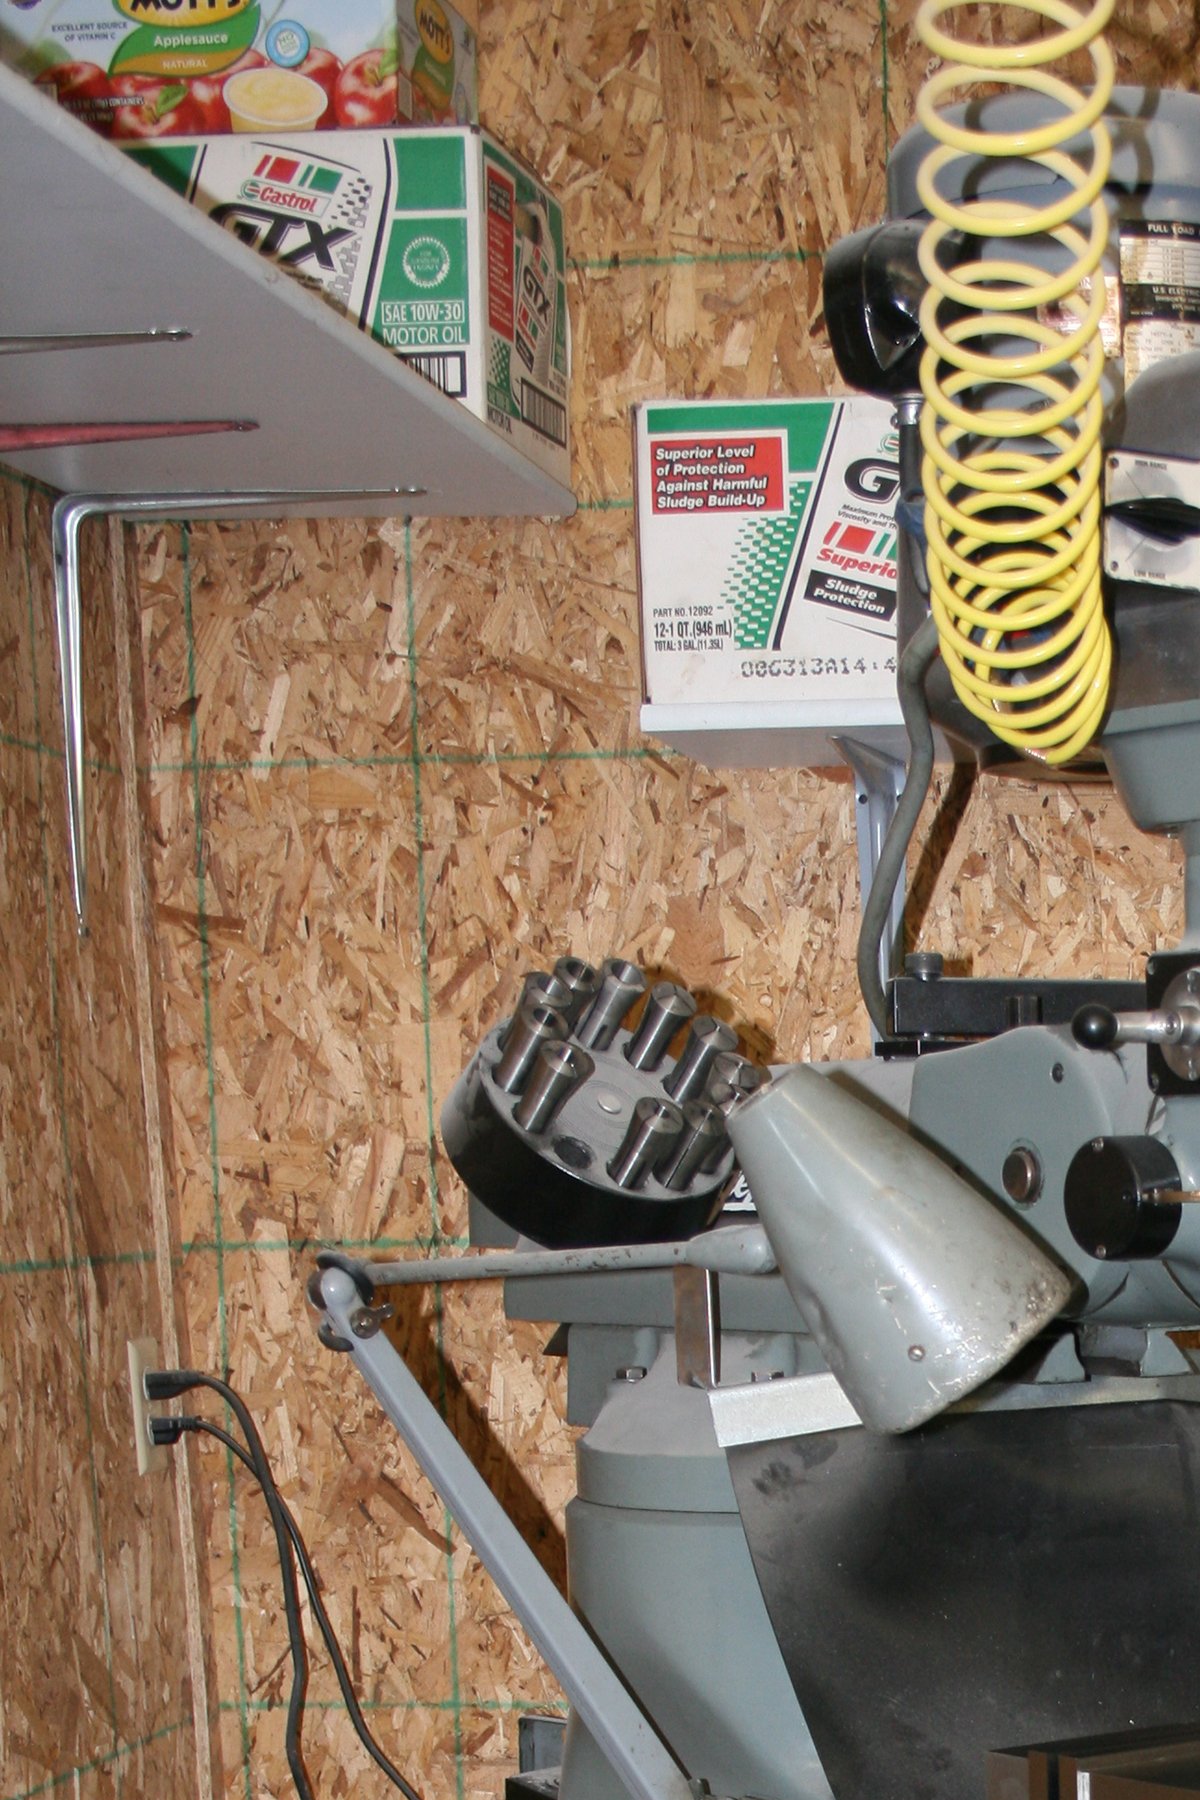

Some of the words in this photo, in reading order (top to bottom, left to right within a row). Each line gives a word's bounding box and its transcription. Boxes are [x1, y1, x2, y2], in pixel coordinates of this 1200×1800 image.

[51, 23, 95, 33] EXCELLENT
[96, 21, 128, 31] SOURCE
[64, 33, 76, 41] OF
[77, 31, 109, 41] VITAMIN
[109, 31, 116, 40] C
[153, 33, 229, 49] Applesauce
[162, 59, 208, 70] NATURAL
[259, 185, 318, 214] Castrol
[208, 202, 357, 272] GTX
[1147, 223, 1169, 234] FULL
[523, 264, 553, 322] GTX
[384, 303, 408, 322] SAE
[410, 302, 462, 321] 10W-30
[383, 327, 439, 345] MOTOR
[442, 326, 467, 343] OIL
[655, 447, 714, 462] Superior
[717, 444, 755, 458] Level
[656, 463, 671, 477] of
[673, 462, 745, 476] Protection
[656, 479, 709, 495] Against
[712, 476, 768, 491] Harmful
[657, 496, 704, 510] Sludge
[707, 493, 766, 507] Build-Up
[842, 503, 878, 518] Maximum
[837, 510, 871, 525] Viscosity
[871, 517, 888, 528] and
[824, 578, 878, 601] Sludge
[812, 587, 886, 615] Protection
[652, 608, 673, 618] PART
[654, 621, 674, 638] 12-1
[715, 619, 733, 639] mL)
[654, 640, 677, 652] TOTAL:
[677, 640, 682, 651] 3
